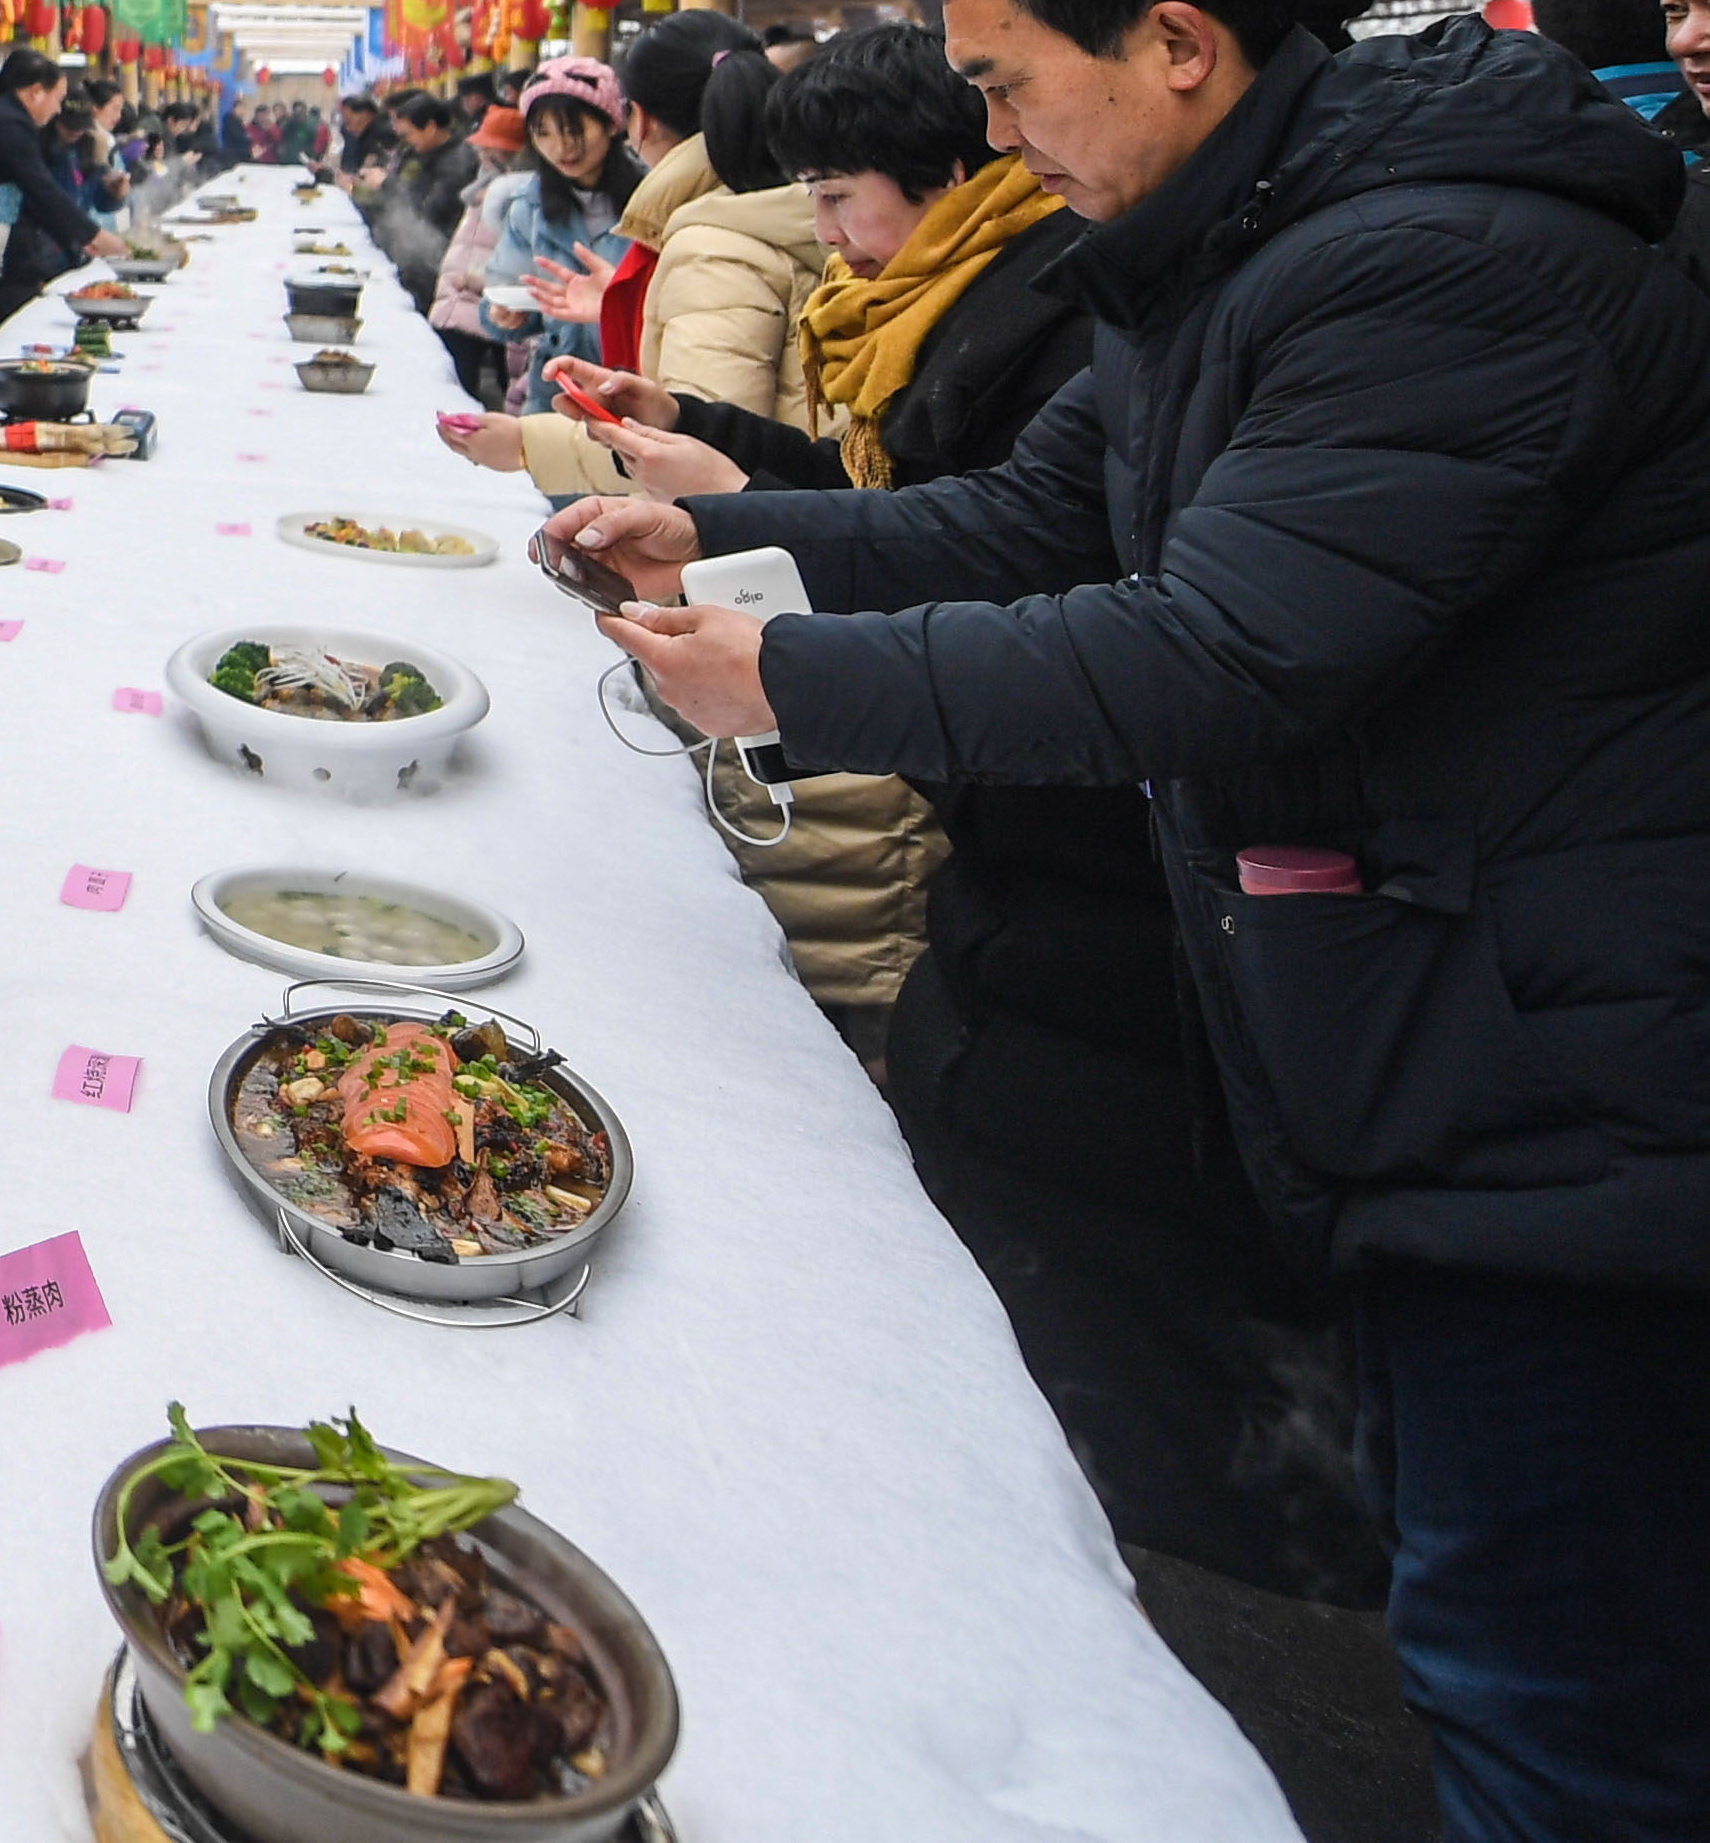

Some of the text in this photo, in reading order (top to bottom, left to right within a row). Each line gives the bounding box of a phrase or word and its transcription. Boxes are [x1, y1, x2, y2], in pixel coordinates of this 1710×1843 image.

[734, 588, 764, 605] aigo
[1, 1279, 64, 1326] 粉蒸肉
